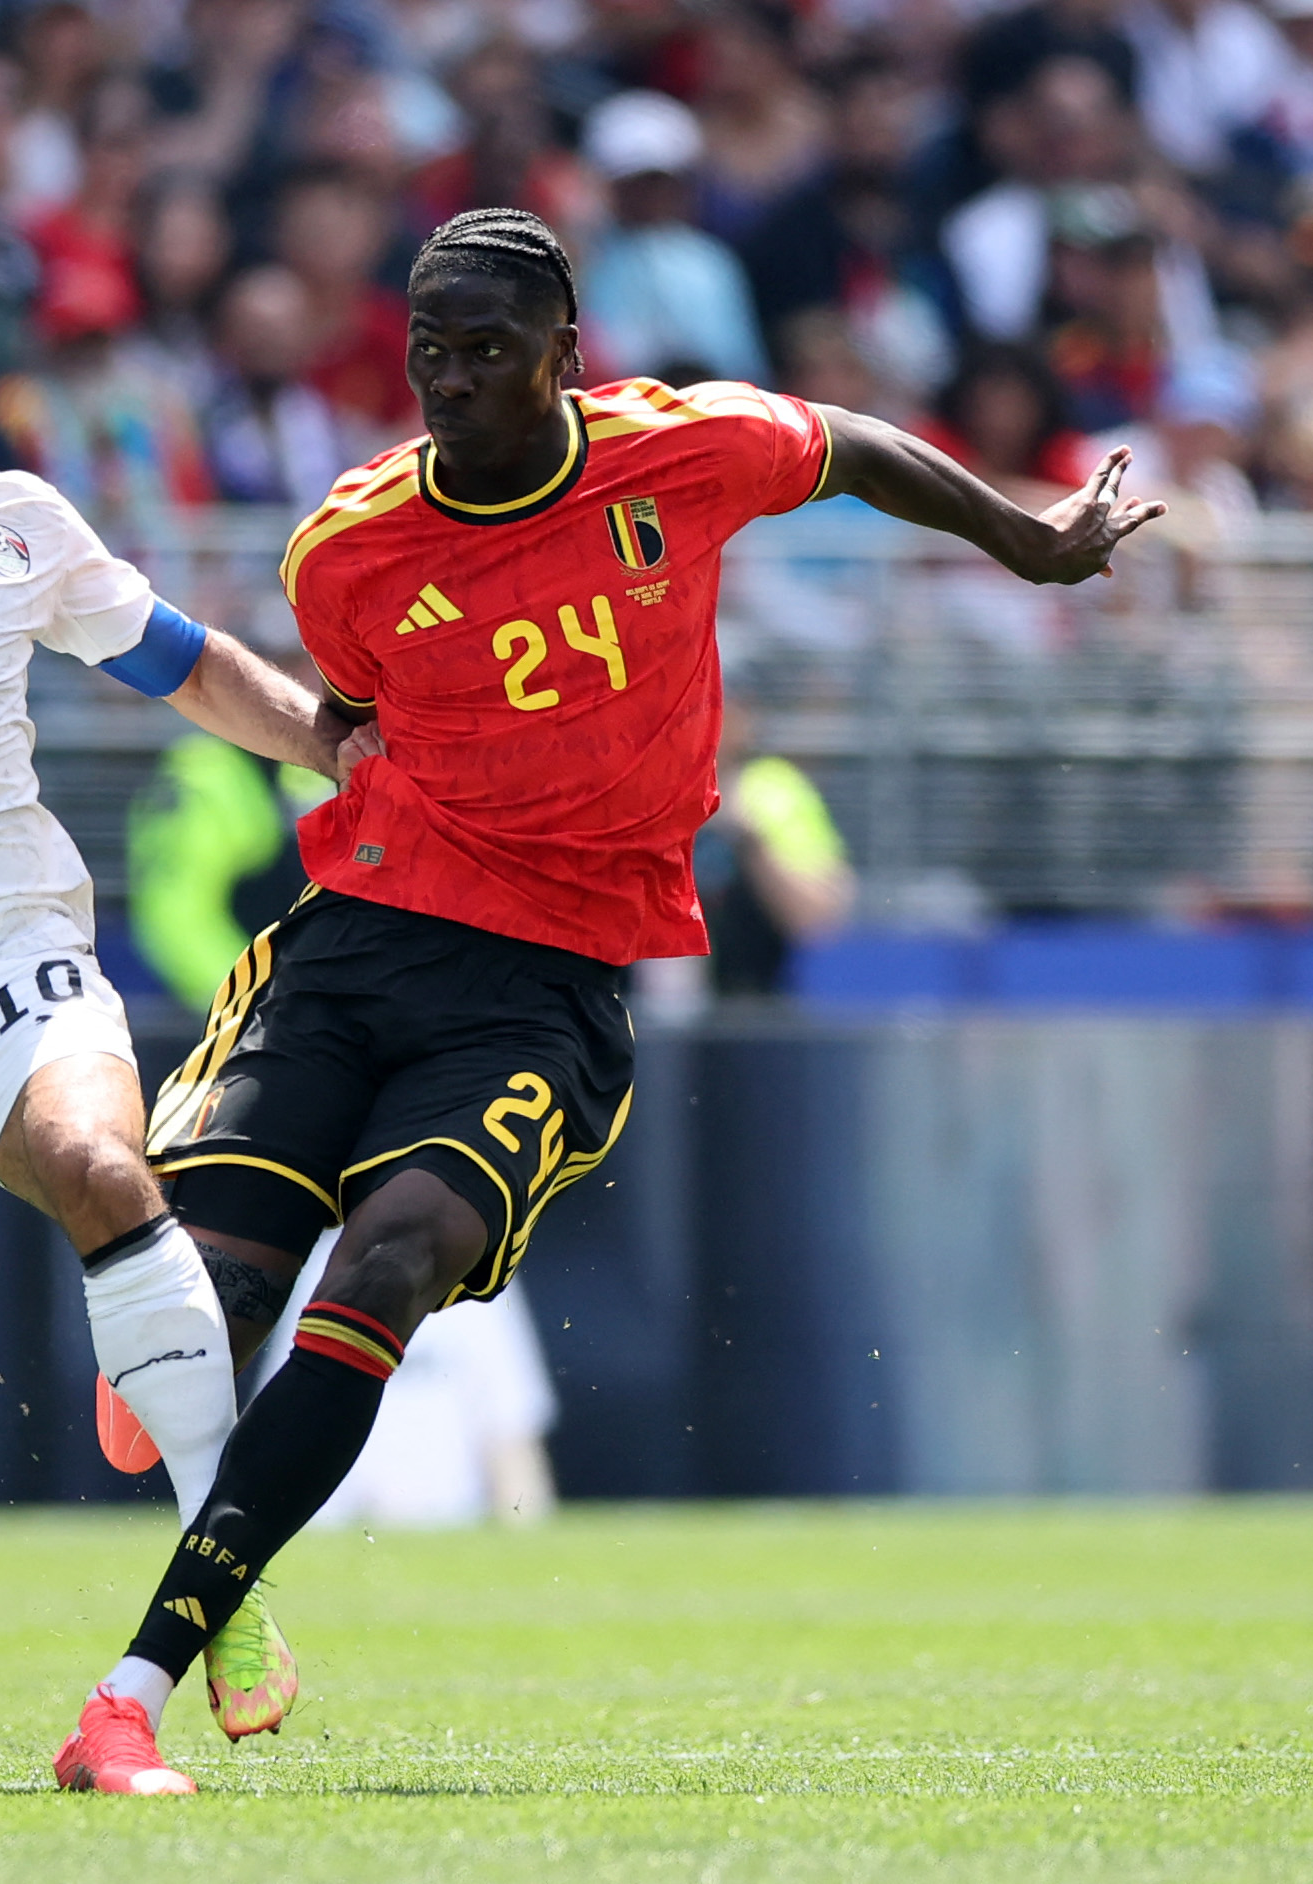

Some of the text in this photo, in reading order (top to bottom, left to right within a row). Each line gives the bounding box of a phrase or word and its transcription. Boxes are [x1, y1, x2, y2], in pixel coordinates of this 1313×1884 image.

[492, 595, 627, 711] 24
[483, 1071, 564, 1202] 24
[185, 1534, 247, 1580] RBFA
